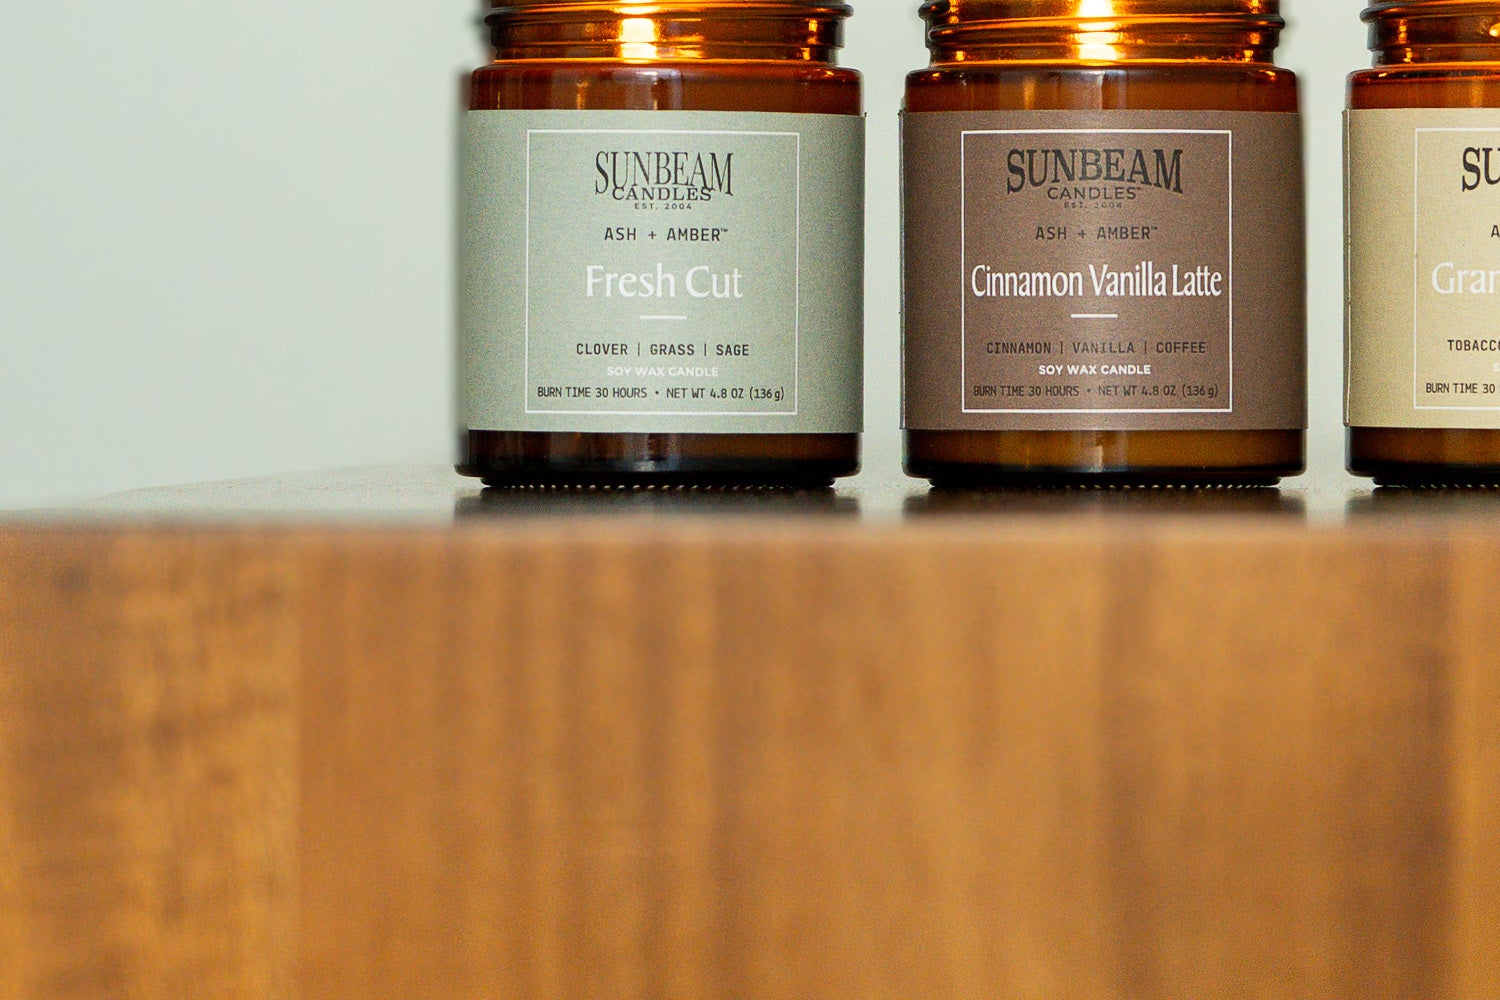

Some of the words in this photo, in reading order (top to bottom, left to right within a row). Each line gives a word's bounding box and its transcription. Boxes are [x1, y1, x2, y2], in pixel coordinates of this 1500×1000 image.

[595, 150, 734, 196] SUNBEAM
[1007, 149, 1183, 194] SUNBEAM
[612, 187, 712, 201] CANDLES
[604, 227, 636, 241] ASH
[1036, 226, 1067, 240] ASH
[586, 263, 676, 298] Fresh
[685, 266, 743, 298] Cut
[972, 264, 1083, 297] Cinnamon
[1089, 261, 1166, 296] Vanilla
[1172, 264, 1222, 297] Latte
[576, 343, 628, 356] CLOVER
[650, 344, 694, 356] GRASS
[716, 344, 750, 356] SAGE
[986, 342, 1050, 354] CINNAMON
[1072, 342, 1134, 354] VANILLA
[1156, 342, 1206, 354] COFFEE
[607, 367, 631, 376] SOY
[636, 367, 664, 376] WAX
[668, 367, 718, 376] CANDLE
[1038, 365, 1063, 375] SOY
[1067, 365, 1097, 375] WAX
[1100, 364, 1151, 375] CANDLE
[538, 387, 562, 397] BURN
[566, 387, 591, 398] TIME
[596, 388, 608, 398] 30
[612, 388, 647, 398] HOURS
[666, 388, 687, 398] NET
[692, 388, 706, 398] WT
[710, 388, 727, 399] 4.8
[731, 388, 744, 399] OZ
[974, 386, 996, 396] BURN
[1000, 386, 1024, 396] TIME
[1029, 386, 1041, 396] 30
[1045, 386, 1079, 396] HOURS
[1098, 386, 1119, 396] NET
[1123, 386, 1137, 396] WT
[1142, 386, 1159, 396] 4.8
[1163, 386, 1176, 396] OZ
[1426, 382, 1449, 394] BURN
[1453, 383, 1478, 394] TIME
[1482, 383, 1495, 394] 30
